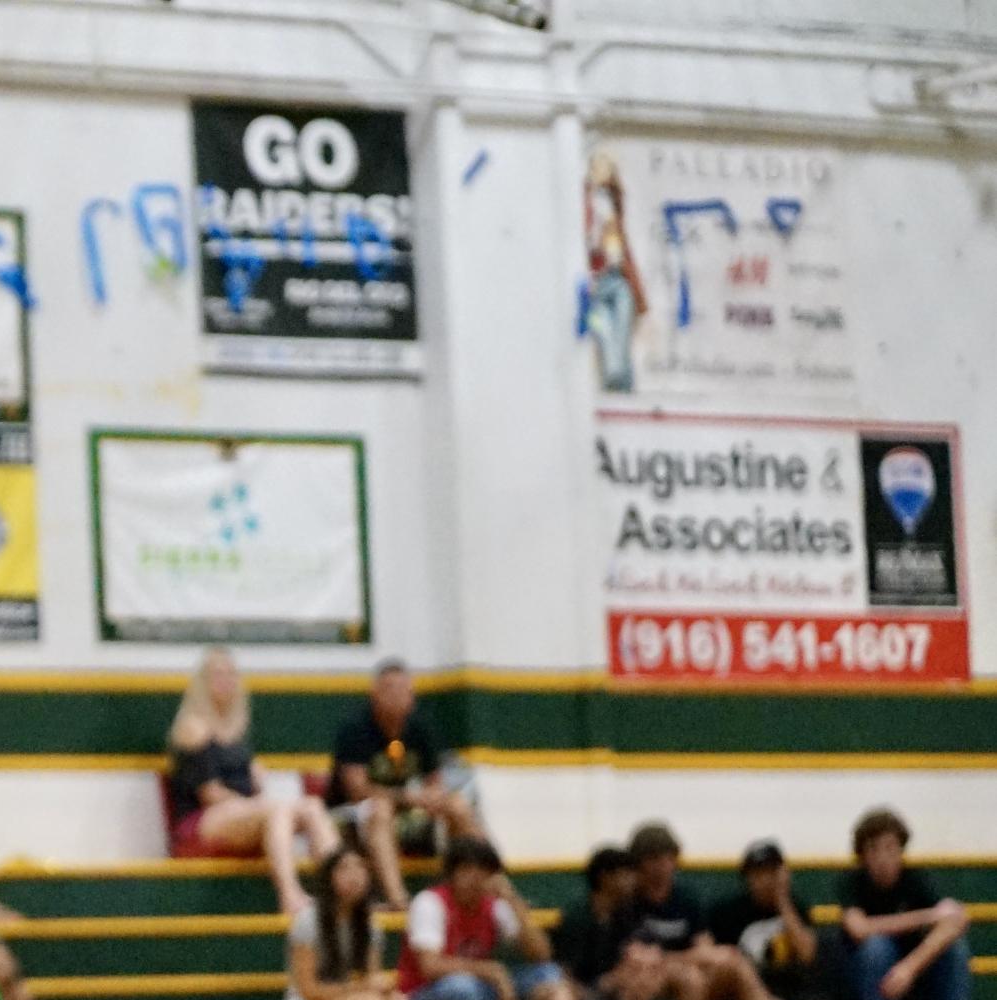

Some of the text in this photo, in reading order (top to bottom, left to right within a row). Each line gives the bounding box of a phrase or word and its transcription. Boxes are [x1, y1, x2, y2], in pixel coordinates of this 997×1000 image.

[243, 113, 359, 188] GO
[594, 437, 807, 502] Augustine
[616, 505, 853, 555] Associates
[619, 616, 931, 677] (916) 541-1607
